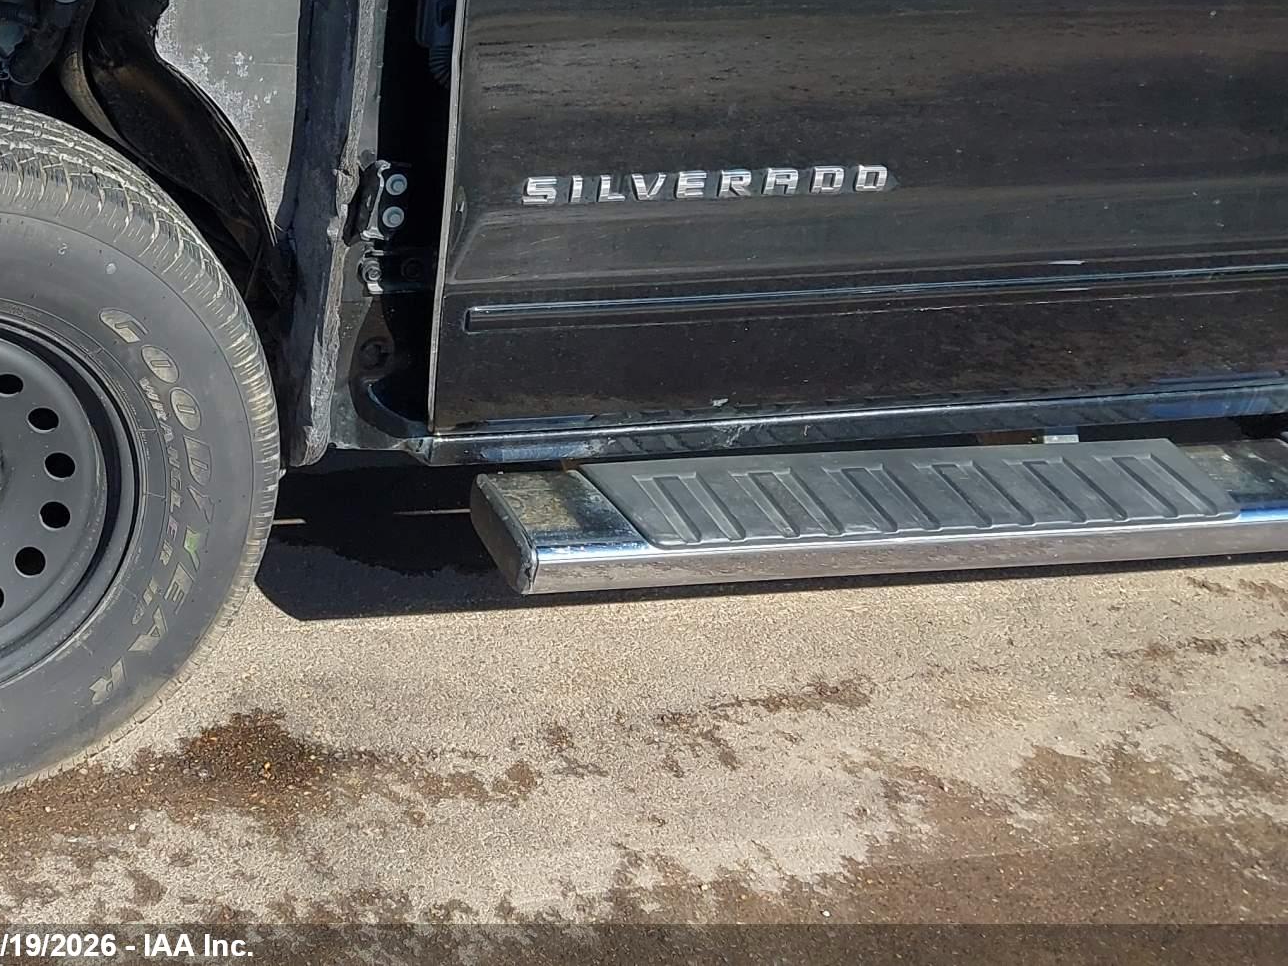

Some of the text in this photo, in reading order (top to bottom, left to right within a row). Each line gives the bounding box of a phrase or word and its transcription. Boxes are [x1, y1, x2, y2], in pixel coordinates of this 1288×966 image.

[521, 164, 889, 206] SILVERADO
[89, 307, 216, 705] GOODYEAR
[139, 377, 182, 566] WRANGLER
